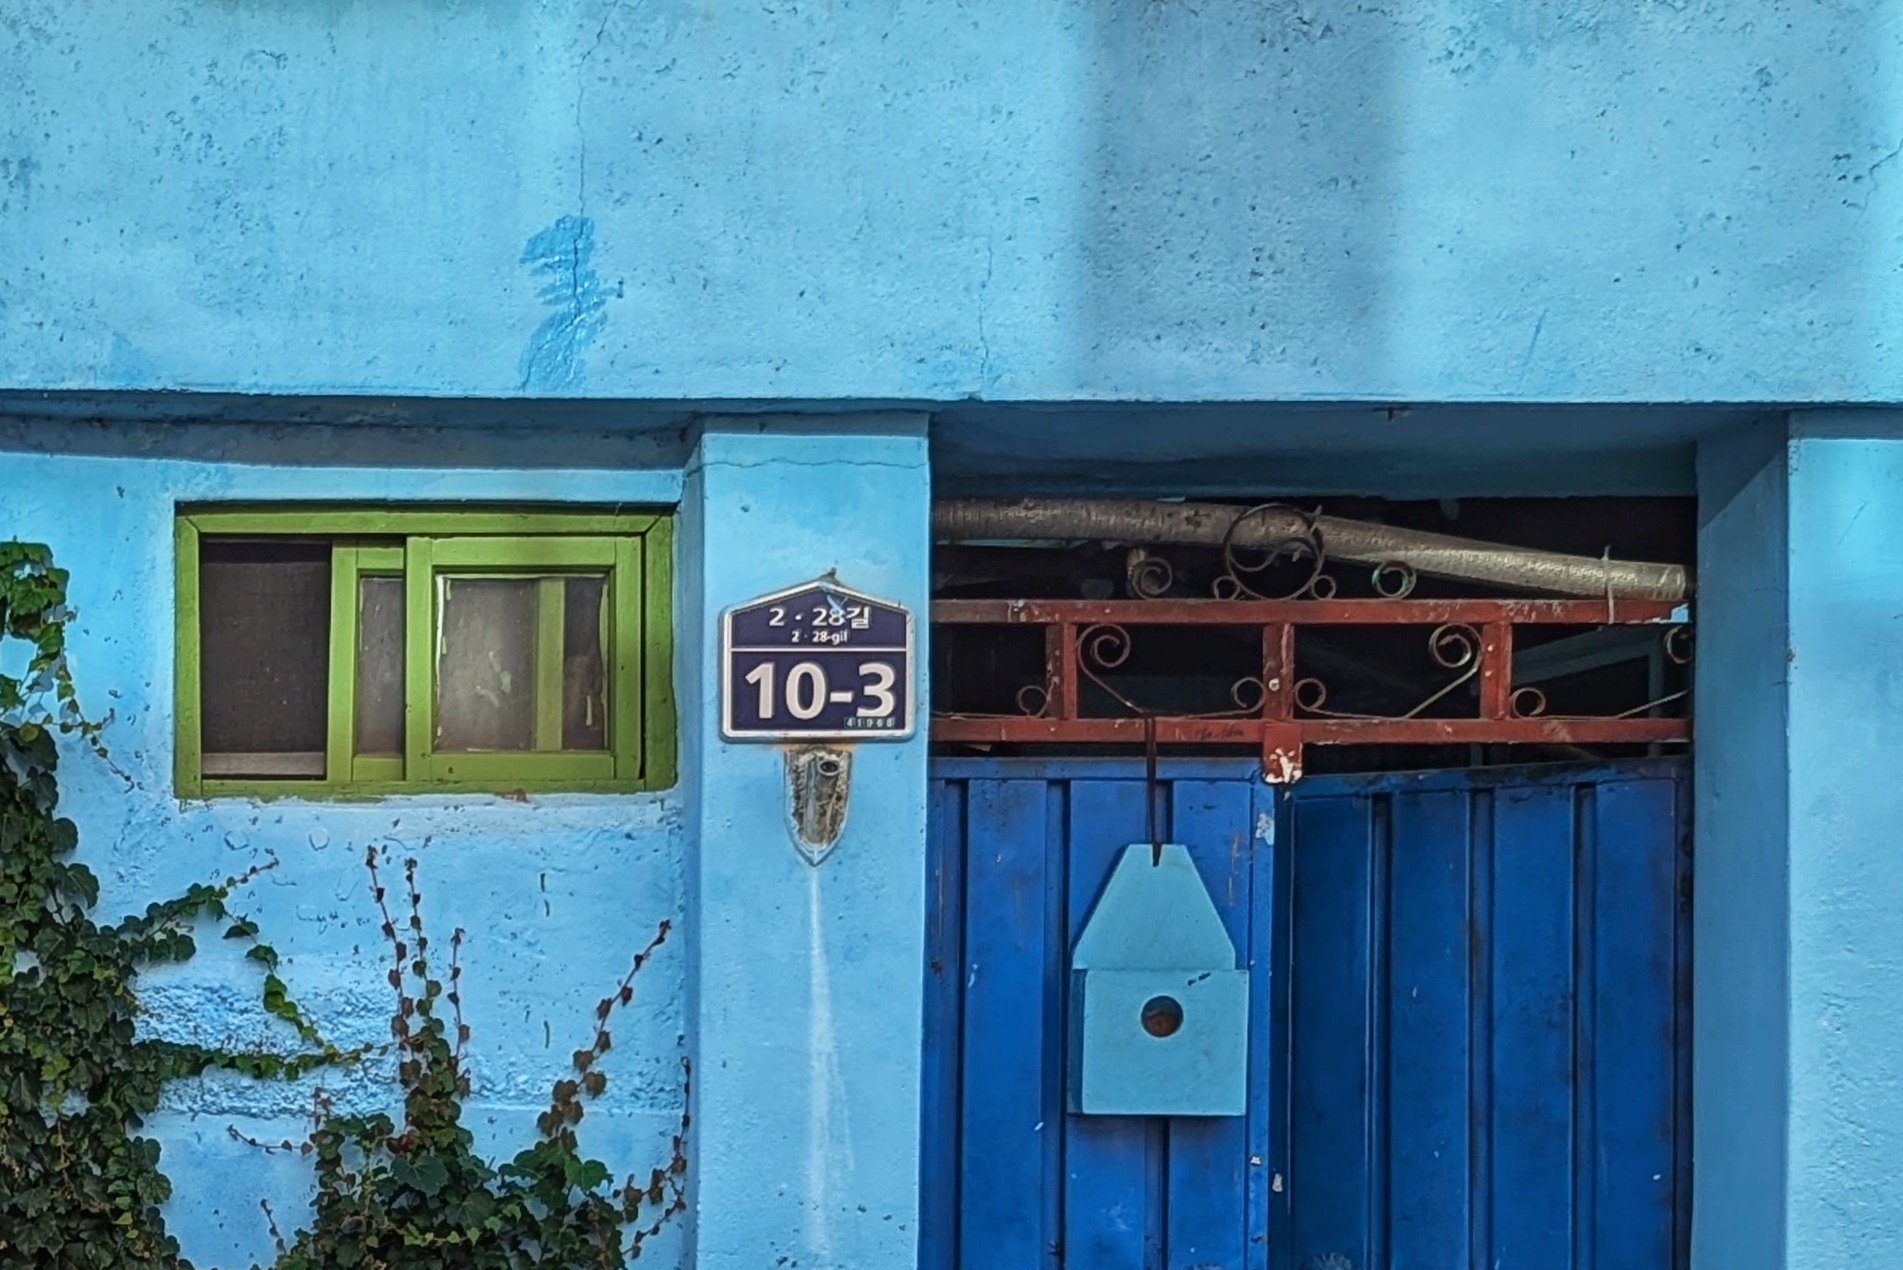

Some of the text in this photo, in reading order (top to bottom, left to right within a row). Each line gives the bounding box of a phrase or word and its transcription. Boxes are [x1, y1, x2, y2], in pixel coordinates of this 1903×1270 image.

[768, 607, 785, 627] 2
[811, 607, 870, 629] 28길
[791, 630, 799, 643] 2
[812, 630, 848, 646] 28-gil
[744, 662, 896, 720] 10-3
